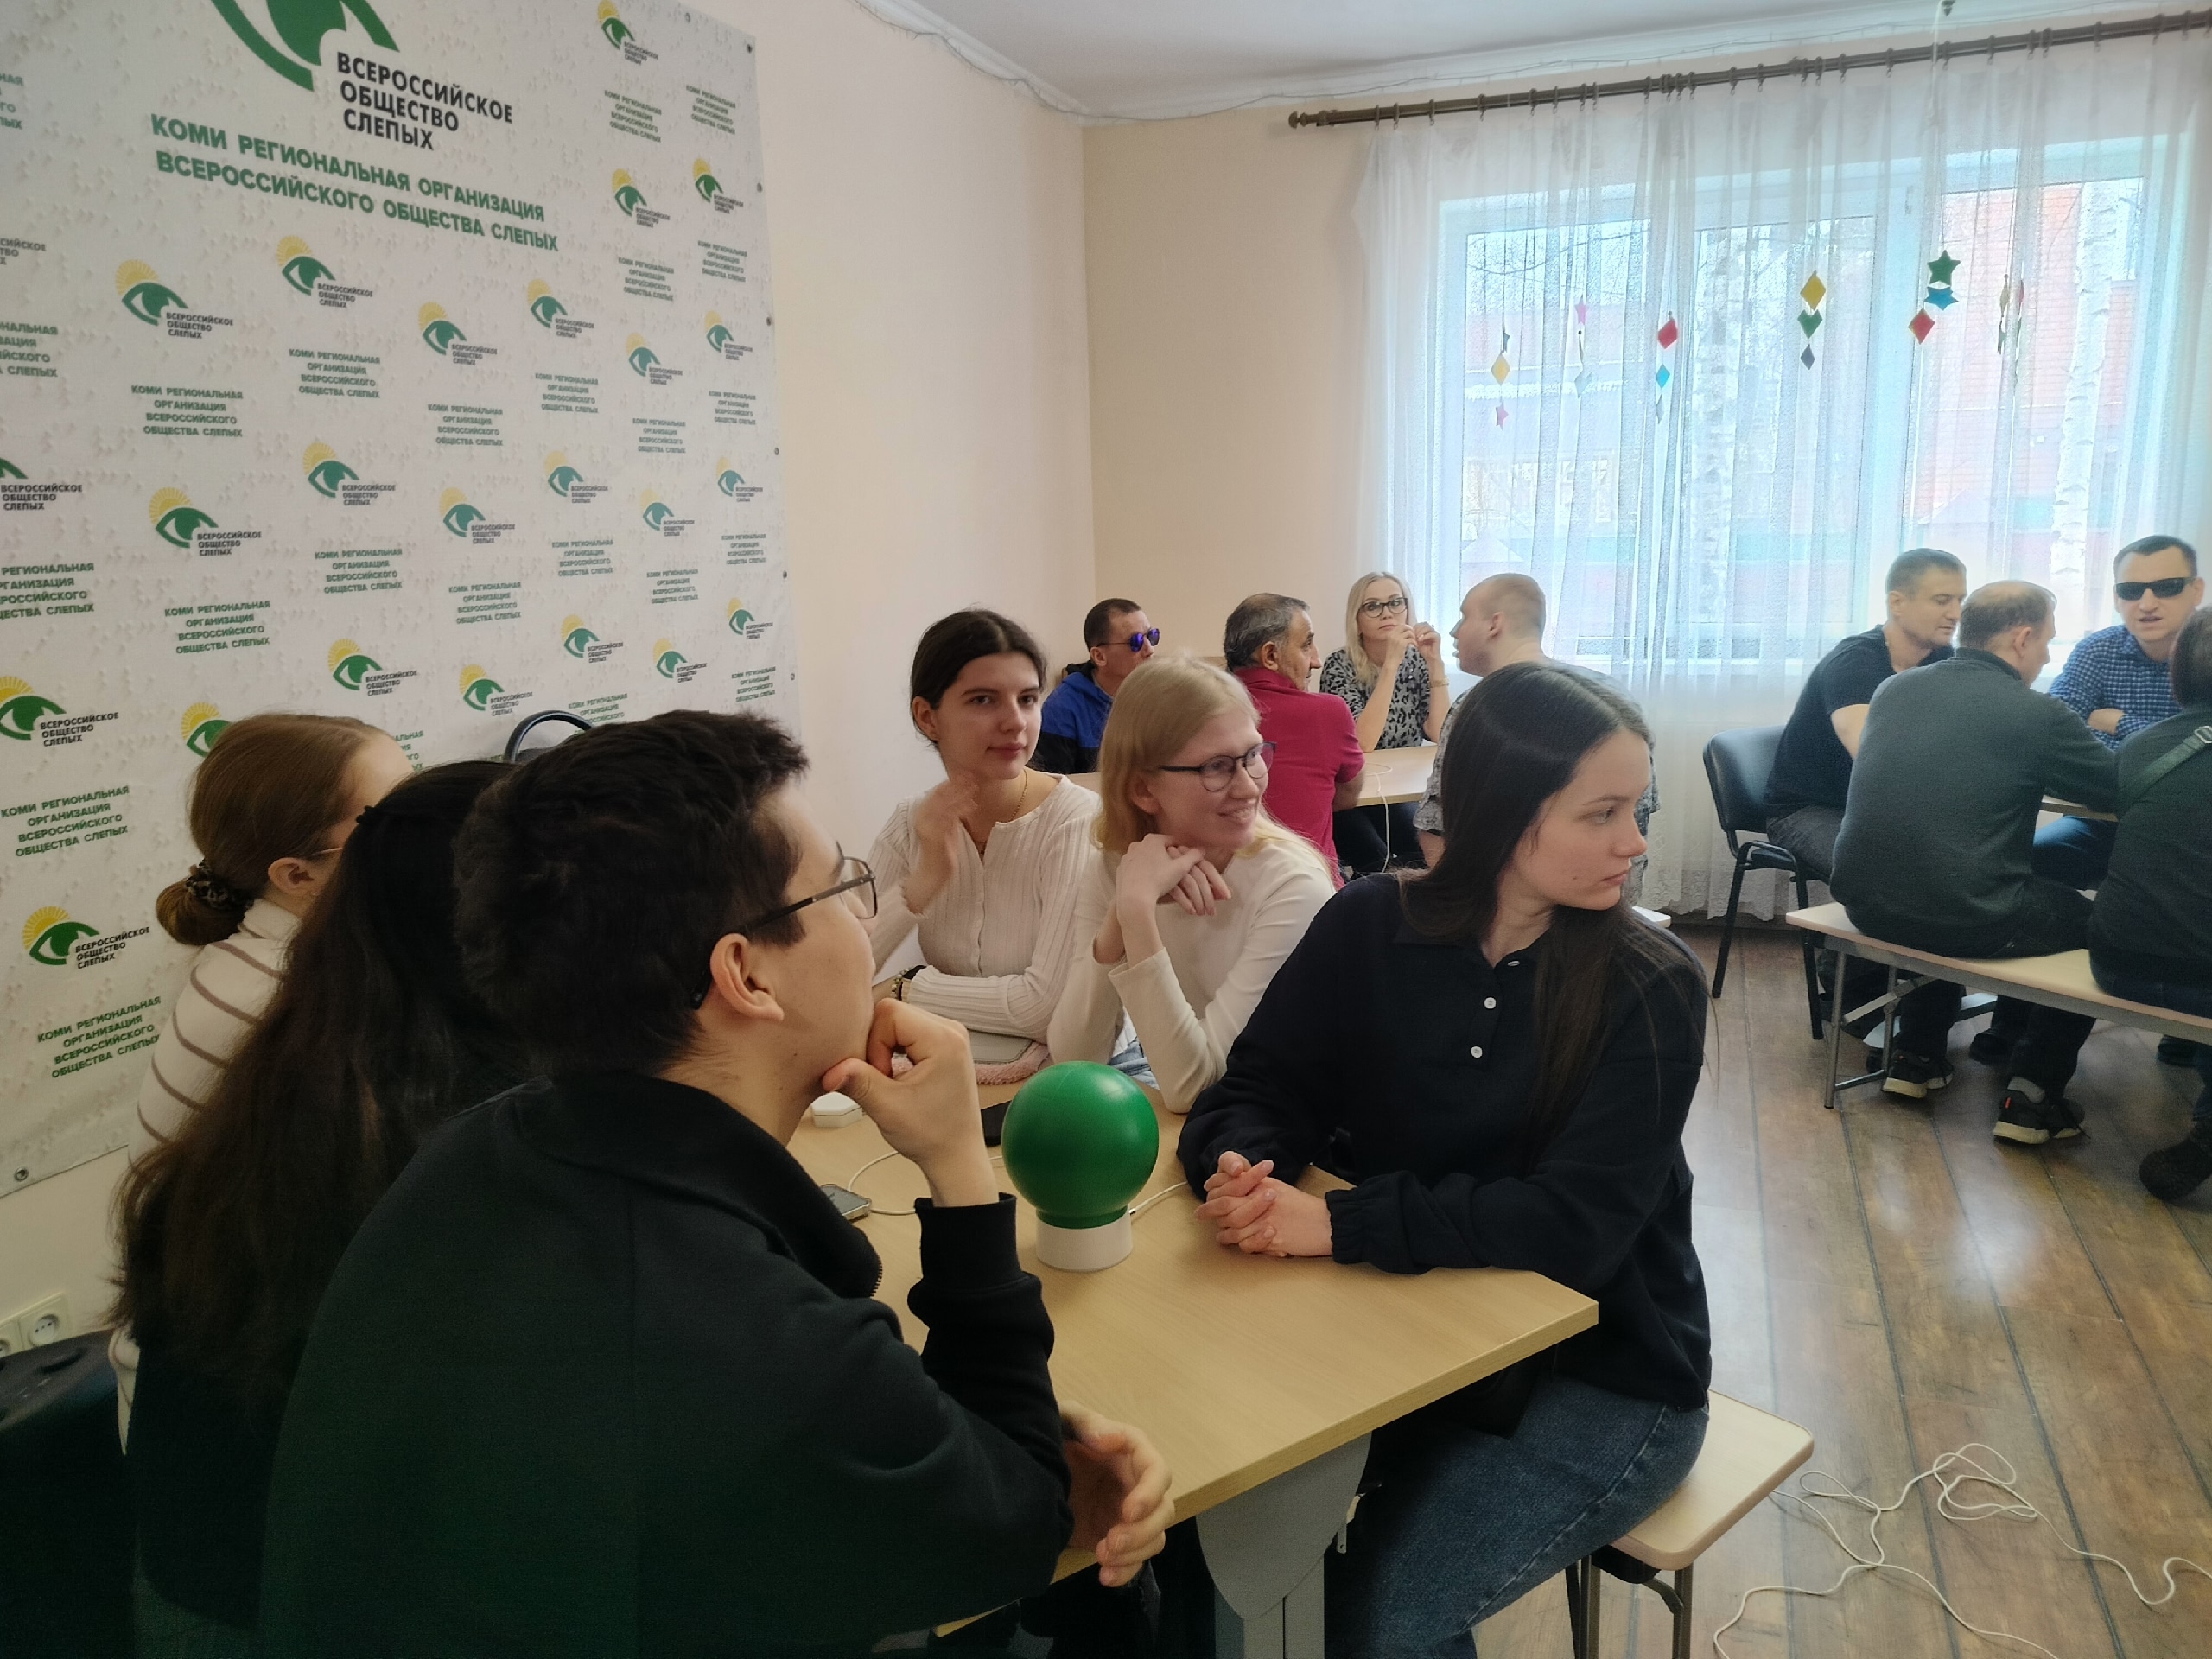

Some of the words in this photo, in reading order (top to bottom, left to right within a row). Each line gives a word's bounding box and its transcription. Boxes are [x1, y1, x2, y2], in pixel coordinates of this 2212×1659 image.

[337, 52, 512, 124] ВСЕРОССИЙСКОЕ
[340, 80, 459, 131] ОБЩЕСТВО
[343, 108, 434, 150] СЛЕПЫХ
[151, 113, 227, 150] КОМИ
[238, 134, 410, 192] РЕГИОНАЛЬНАЯ
[418, 178, 544, 222] ОРГАНИЗАЦИЯ
[156, 150, 374, 213] ВСЕРОССИЙСКОГО
[383, 200, 485, 236] ОБЩЕСТВА
[491, 223, 558, 251] СЛЕПЫХ
[0, 238, 46, 251] СИЙСКОЕ
[166, 312, 233, 326] ВСЕРОССИЙСКОЕ
[0, 321, 58, 335] НАЛЬНАЯ
[167, 321, 212, 332] ОБЩЕСТВО
[168, 329, 202, 339] СЛЕПЫХ
[131, 385, 162, 395] КОМИ
[166, 387, 244, 399] РЕГИОНАЛЬНАЯ
[154, 399, 226, 412] ОРГАНИЗАЦИЯ
[146, 412, 237, 424] ВСЕРОССИЙСКОГО
[143, 426, 200, 436] ОБЩЕСТВА
[202, 428, 243, 437] СЛЕПЫХ
[1, 483, 82, 493] ВСЕРОССИЙСКОЕ
[2, 493, 56, 502] ОБЩЕСТВО
[3, 502, 44, 511] СЛЕПЫХ
[197, 531, 261, 540] ВСЕРОССИЙСКОЕ
[198, 540, 241, 549] ОБЩЕСТВО
[200, 548, 232, 556] СЛЕПЫХ
[1, 563, 94, 576] РЕГИОНАЛЬНАЯ
[0, 577, 74, 590] ГАНИЗАЦИЯ
[0, 591, 87, 605] РОССИЙСКОГО
[0, 607, 41, 620] ЕСТВА
[46, 603, 94, 615] СЛЕПЫХ
[164, 607, 194, 617] КОМИ
[197, 601, 270, 613] РЕГИОНАЛЬНАЯ
[186, 613, 254, 627] ОРГАНИЗАЦИЯ
[177, 626, 264, 641] ВСЕРОССИЙСКОГО
[175, 641, 228, 654] ОБЩЕСТВА
[232, 637, 270, 648] СЛЕПЫХ
[40, 712, 118, 730] ВСЕРОССИЙСКОЕ
[41, 724, 94, 738] ОБЩЕСТВО
[43, 734, 82, 747] СЛЕПЫХ
[1, 804, 37, 817] КОМИ
[41, 785, 130, 810] РЕГИОНАЛЬНАЯ
[27, 803, 111, 827] ОРГАНИЗАЦИЯ
[17, 814, 123, 842] ВСЕРОССИЙСКОГО
[16, 836, 80, 856] ОБЩЕСТВА
[84, 825, 128, 842] СЛЕПЫХ
[75, 926, 149, 953] ВСЕРОССИЙСКОЕ
[76, 942, 126, 961] ОБЩЕСТВО
[78, 953, 115, 969] СЛЕПЫХ
[37, 1026, 72, 1043] КОМИ
[76, 996, 161, 1030] РЕГИОНАЛЬНАЯ
[63, 1014, 143, 1047] ОРГАНИЗАЦИЯ
[54, 1024, 155, 1065] ВСЕРОССИЙСКОГО
[52, 1052, 113, 1078] ОБЩЕСТВА
